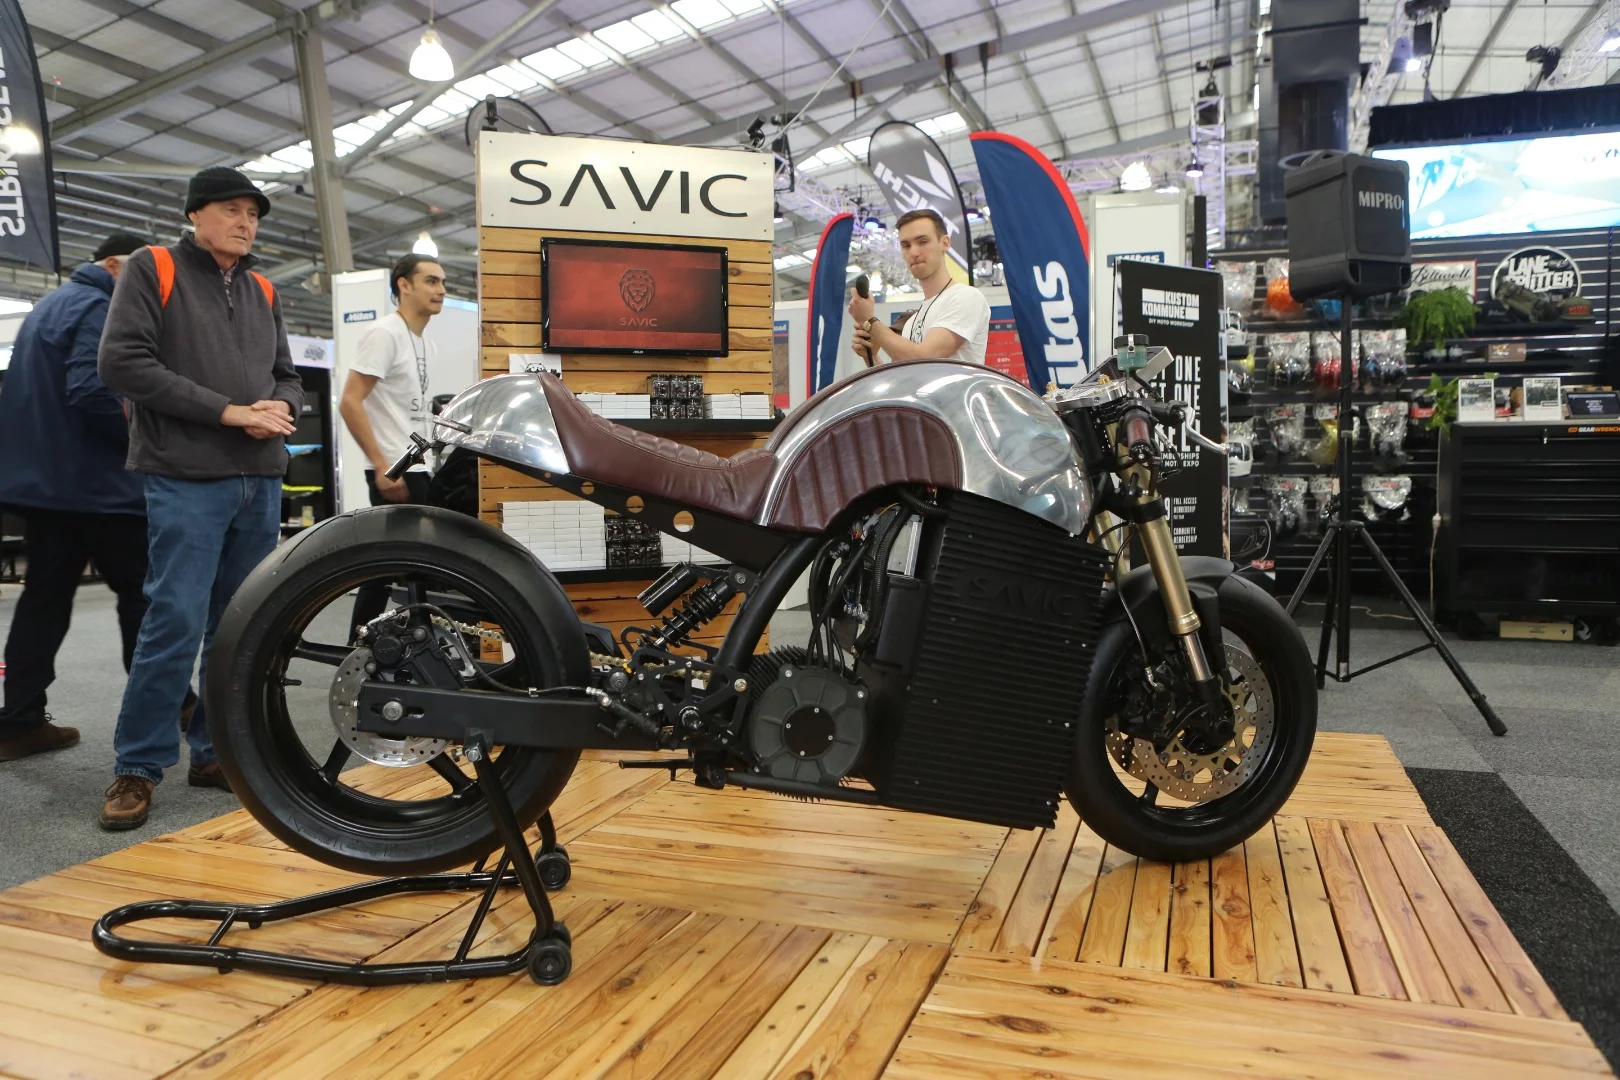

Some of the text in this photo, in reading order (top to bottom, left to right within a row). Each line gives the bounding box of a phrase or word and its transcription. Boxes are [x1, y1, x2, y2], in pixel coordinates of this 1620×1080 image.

[509, 158, 749, 218] SAVIC
[1358, 190, 1402, 210] MIPRO
[1508, 254, 1551, 276] LANE
[1142, 301, 1186, 318] KOMMUNE
[1165, 290, 1200, 308] KUSTOM
[619, 316, 659, 327] SAVIC
[1032, 260, 1090, 387] itas
[1175, 354, 1201, 382] ONE
